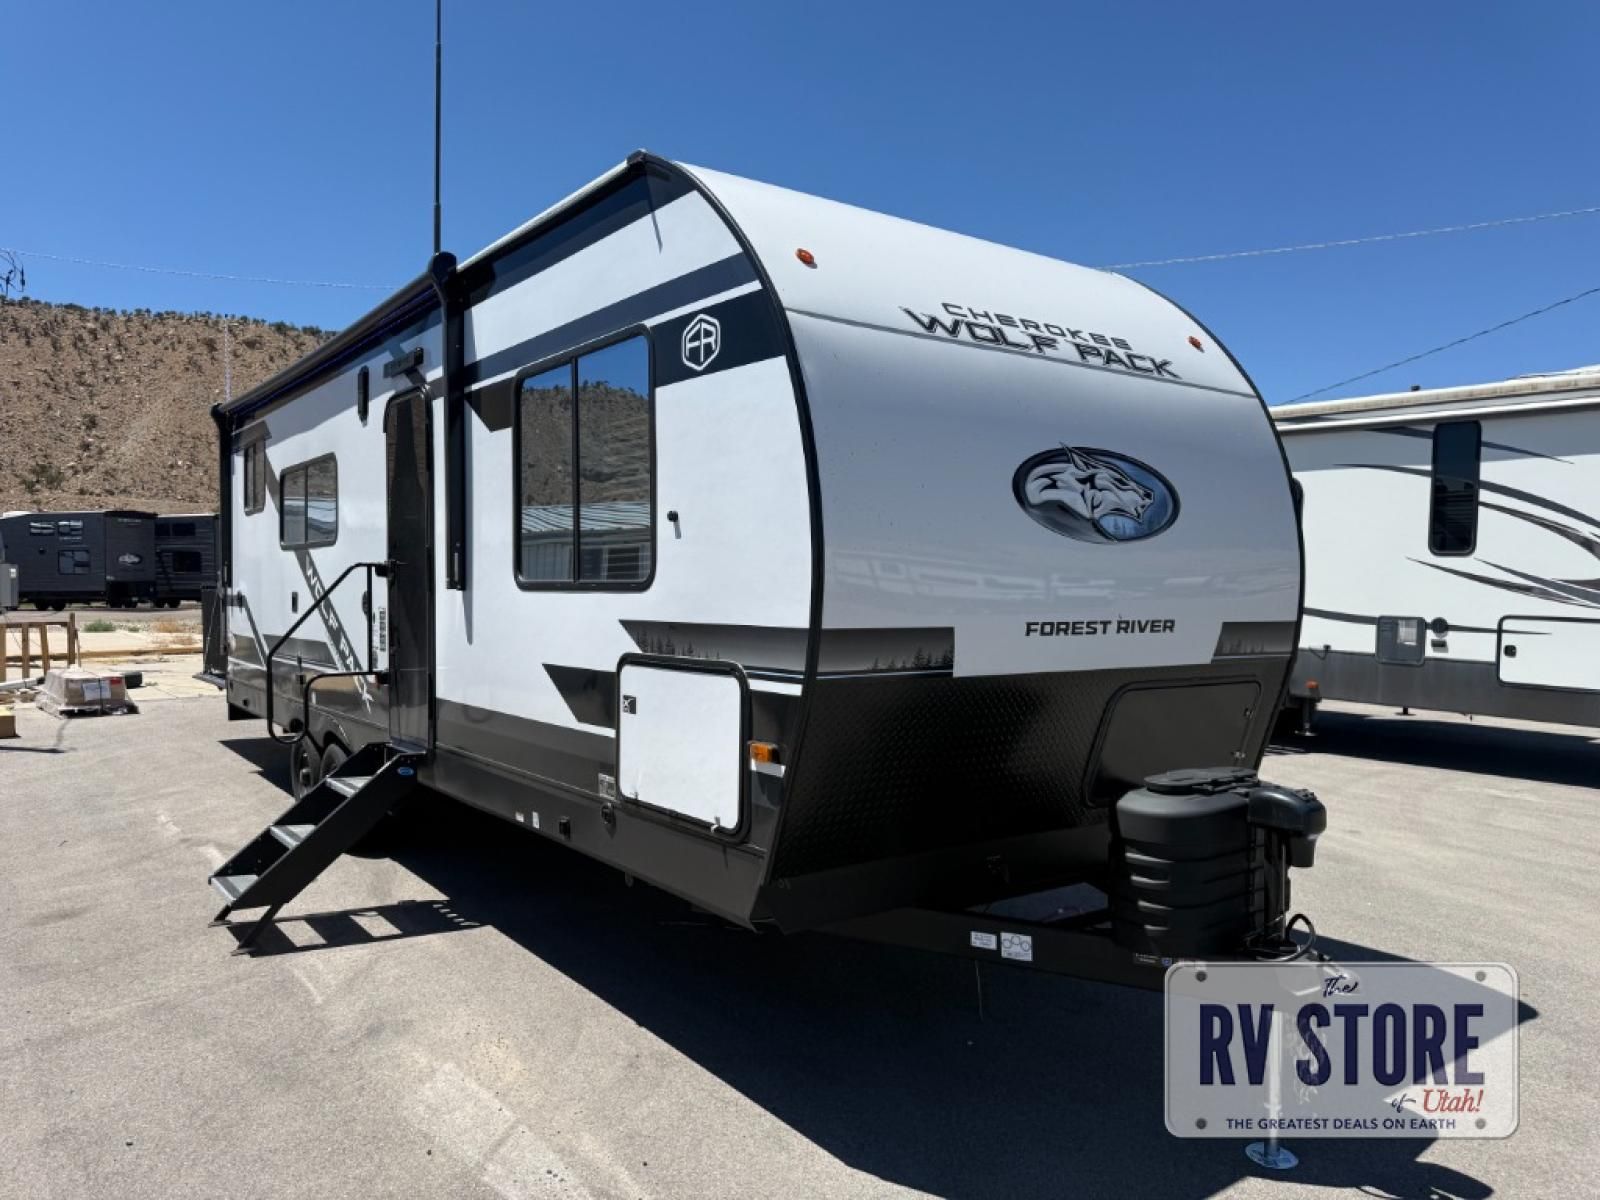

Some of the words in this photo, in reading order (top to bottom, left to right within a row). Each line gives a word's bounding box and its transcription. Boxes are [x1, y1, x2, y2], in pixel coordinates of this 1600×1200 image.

[898, 305, 1059, 354] WOLF
[1066, 340, 1183, 380] PACK
[941, 301, 1133, 351] CHEROKEE
[1025, 620, 1112, 637] FOREST
[1116, 619, 1176, 635] RIVER
